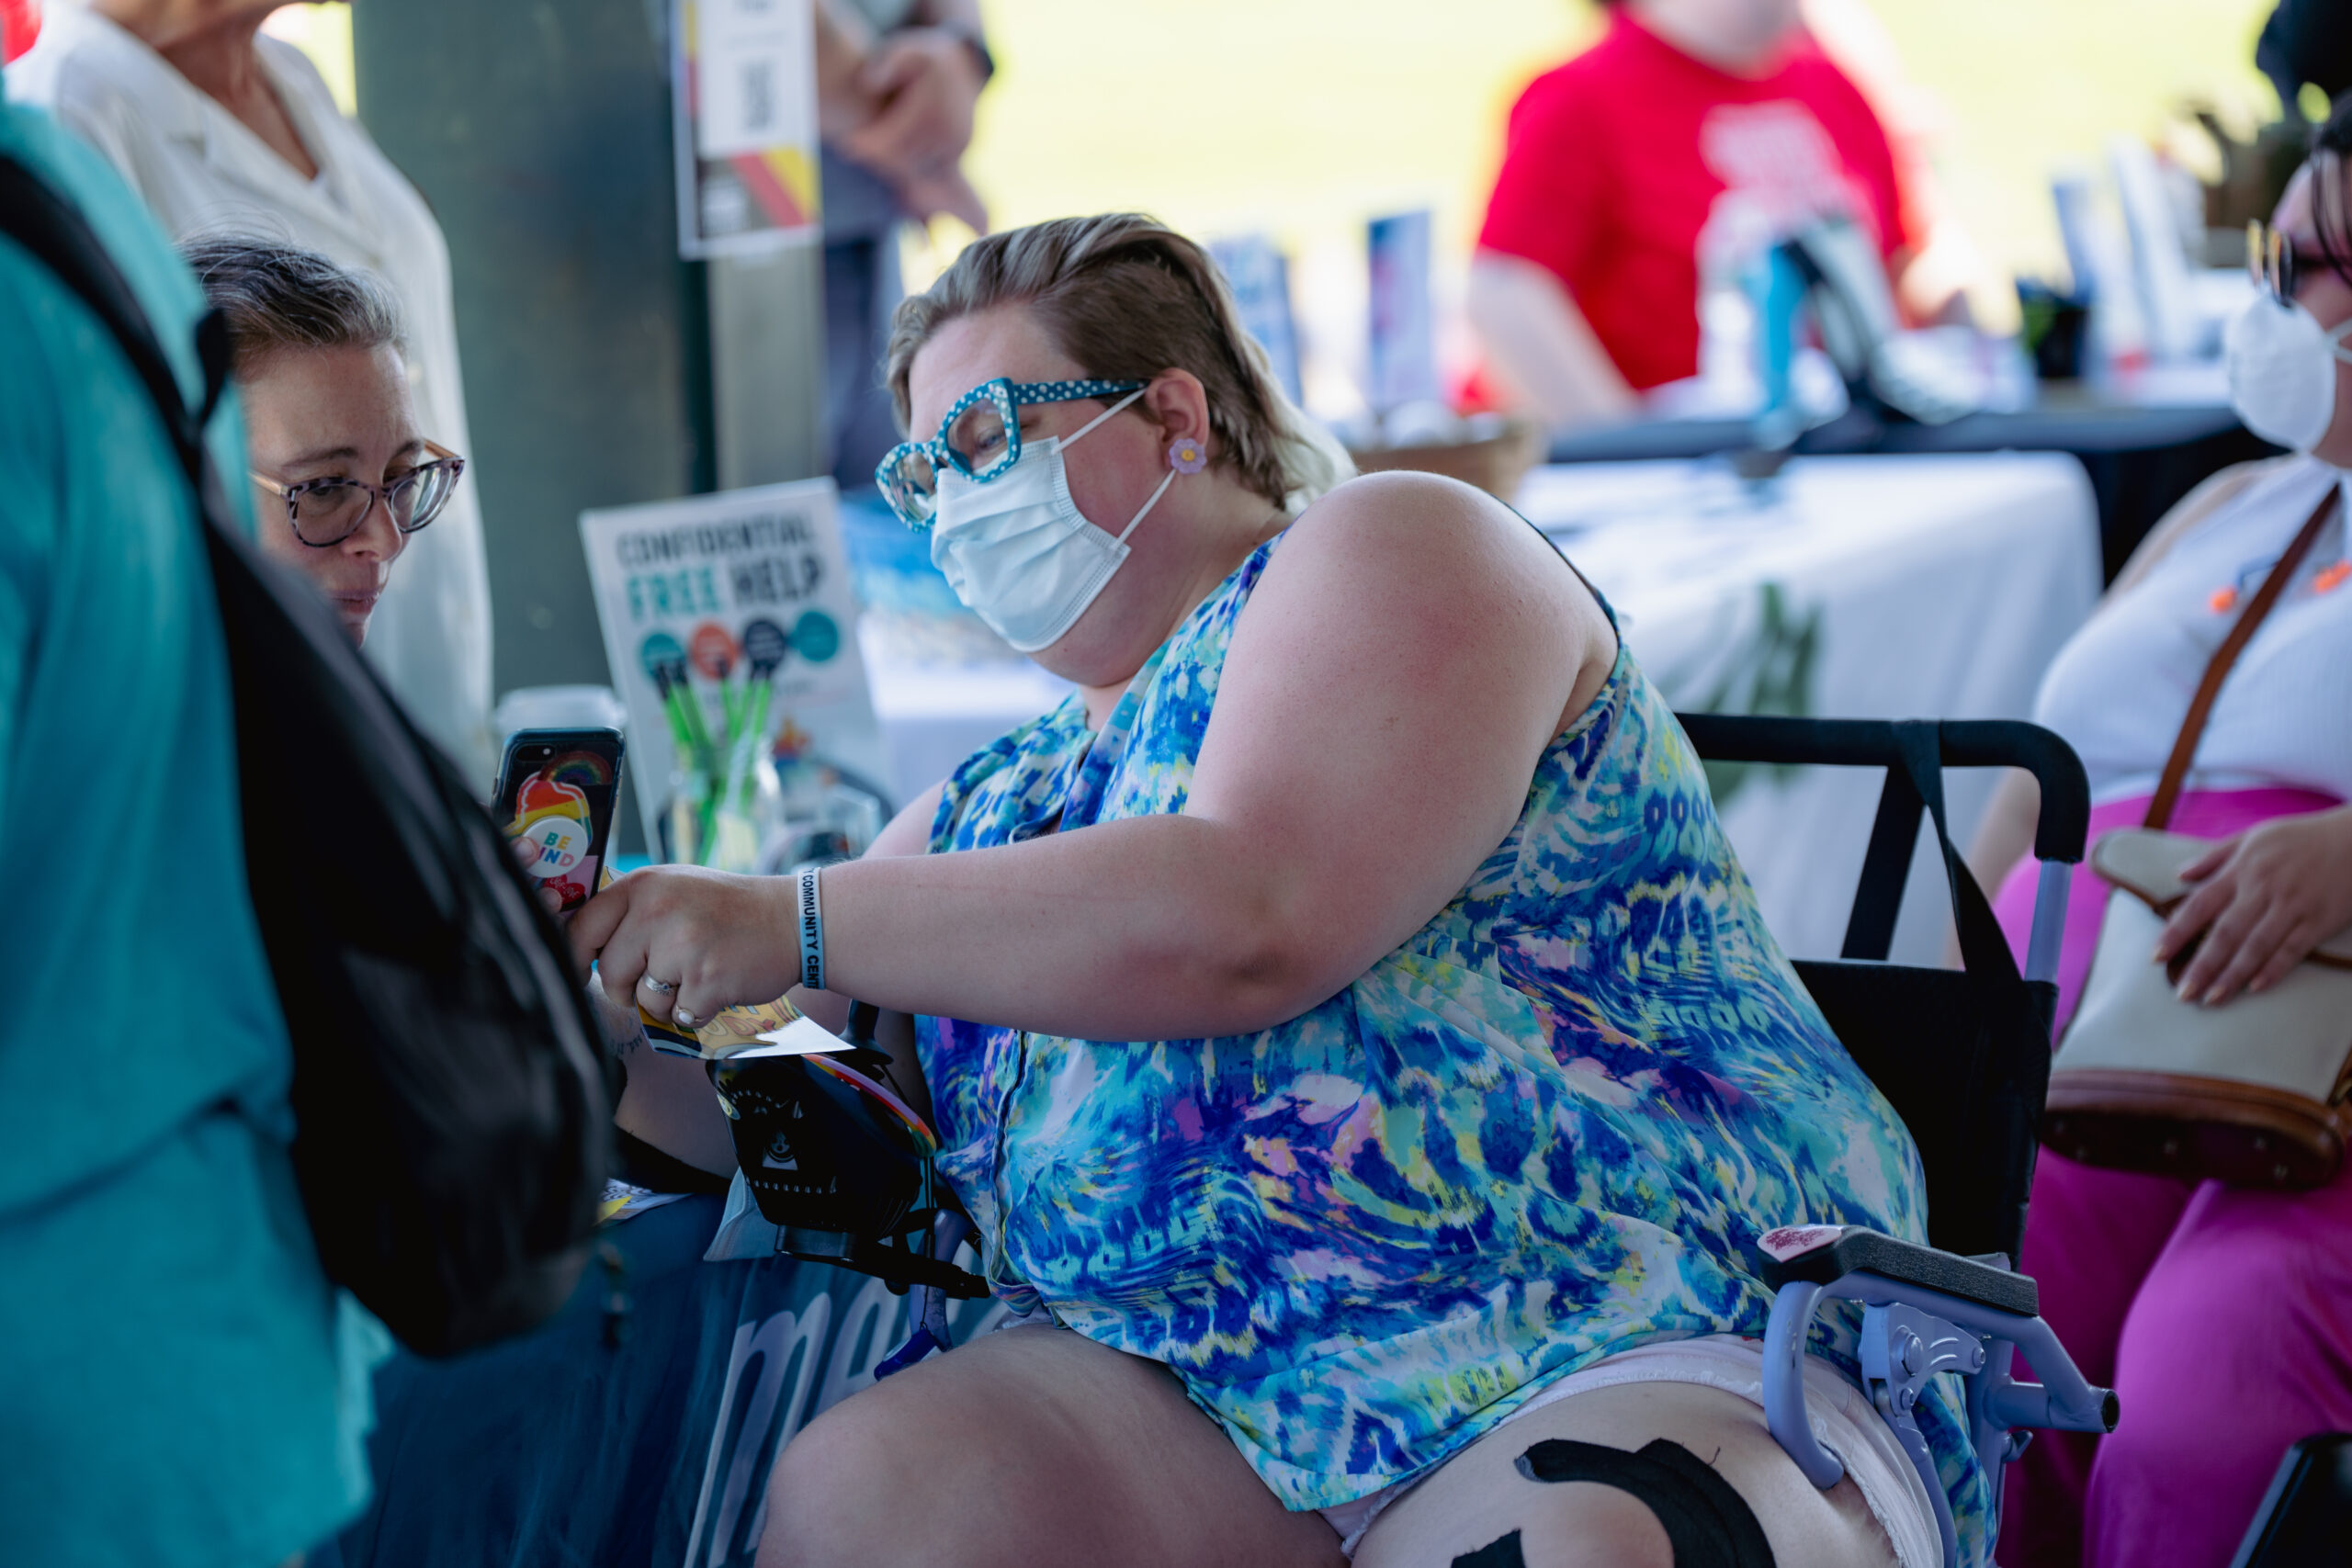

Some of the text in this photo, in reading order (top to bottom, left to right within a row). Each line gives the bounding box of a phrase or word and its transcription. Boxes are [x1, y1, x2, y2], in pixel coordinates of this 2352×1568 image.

[616, 517, 814, 567] CONFIDENTIAL
[627, 555, 822, 621] FREE HELP
[538, 847, 574, 867] IND
[544, 831, 571, 851] BE
[802, 874, 819, 951] COMMUNITY
